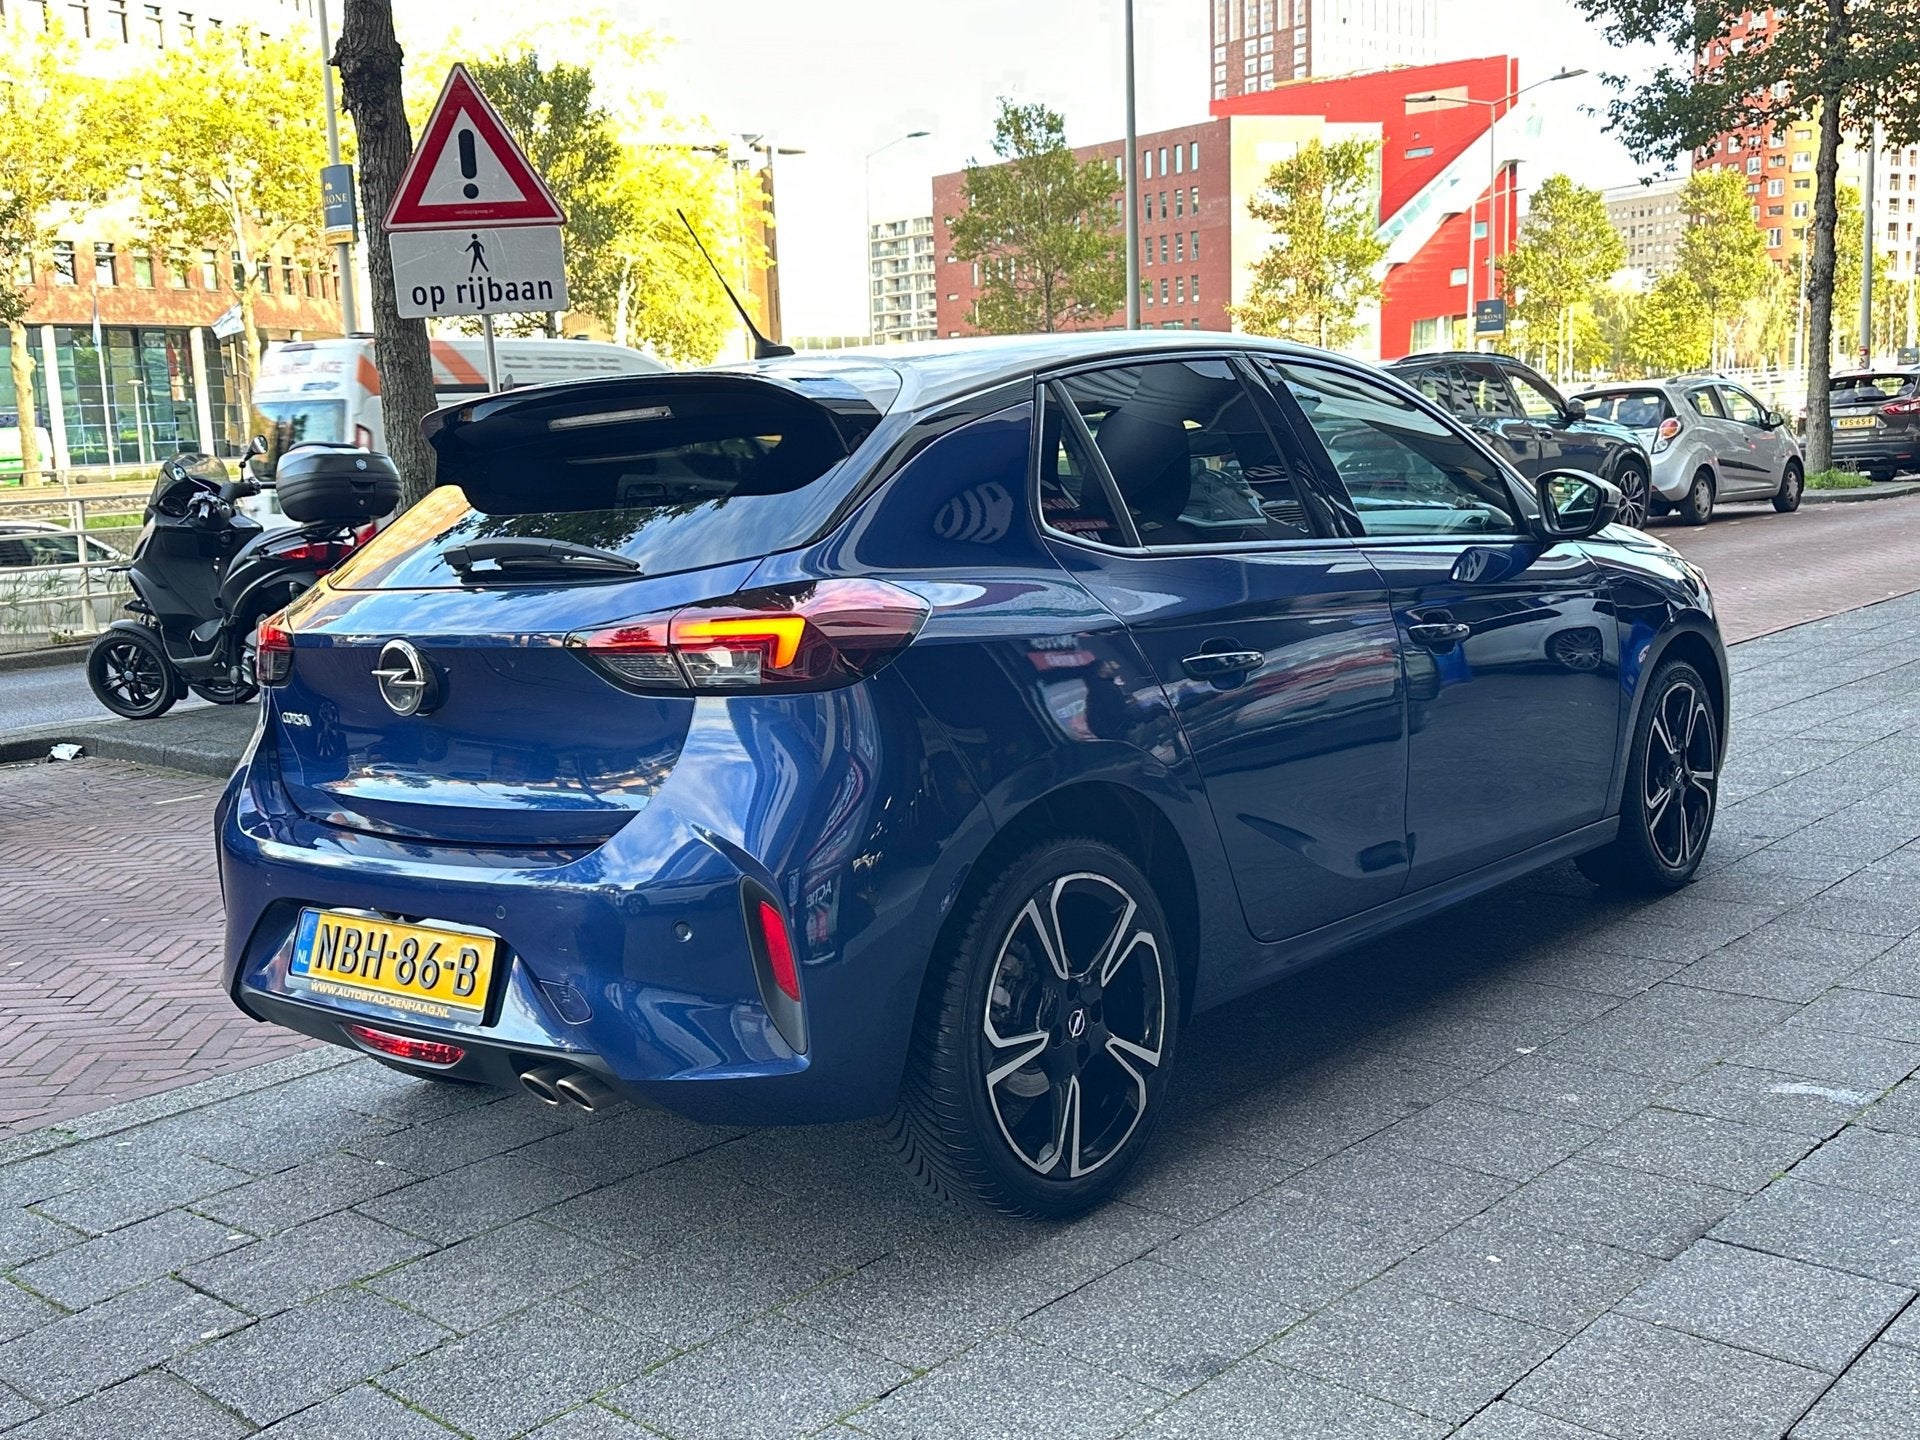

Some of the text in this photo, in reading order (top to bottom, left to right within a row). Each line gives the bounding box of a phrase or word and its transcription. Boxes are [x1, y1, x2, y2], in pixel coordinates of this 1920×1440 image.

[412, 276, 553, 312] op rijbaan
[282, 711, 312, 727] CORSA
[296, 949, 309, 964] NL
[315, 924, 479, 997] NBH-86-B
[310, 980, 451, 1018] WWW.AUTOSTAD-DENHAAG.NL
